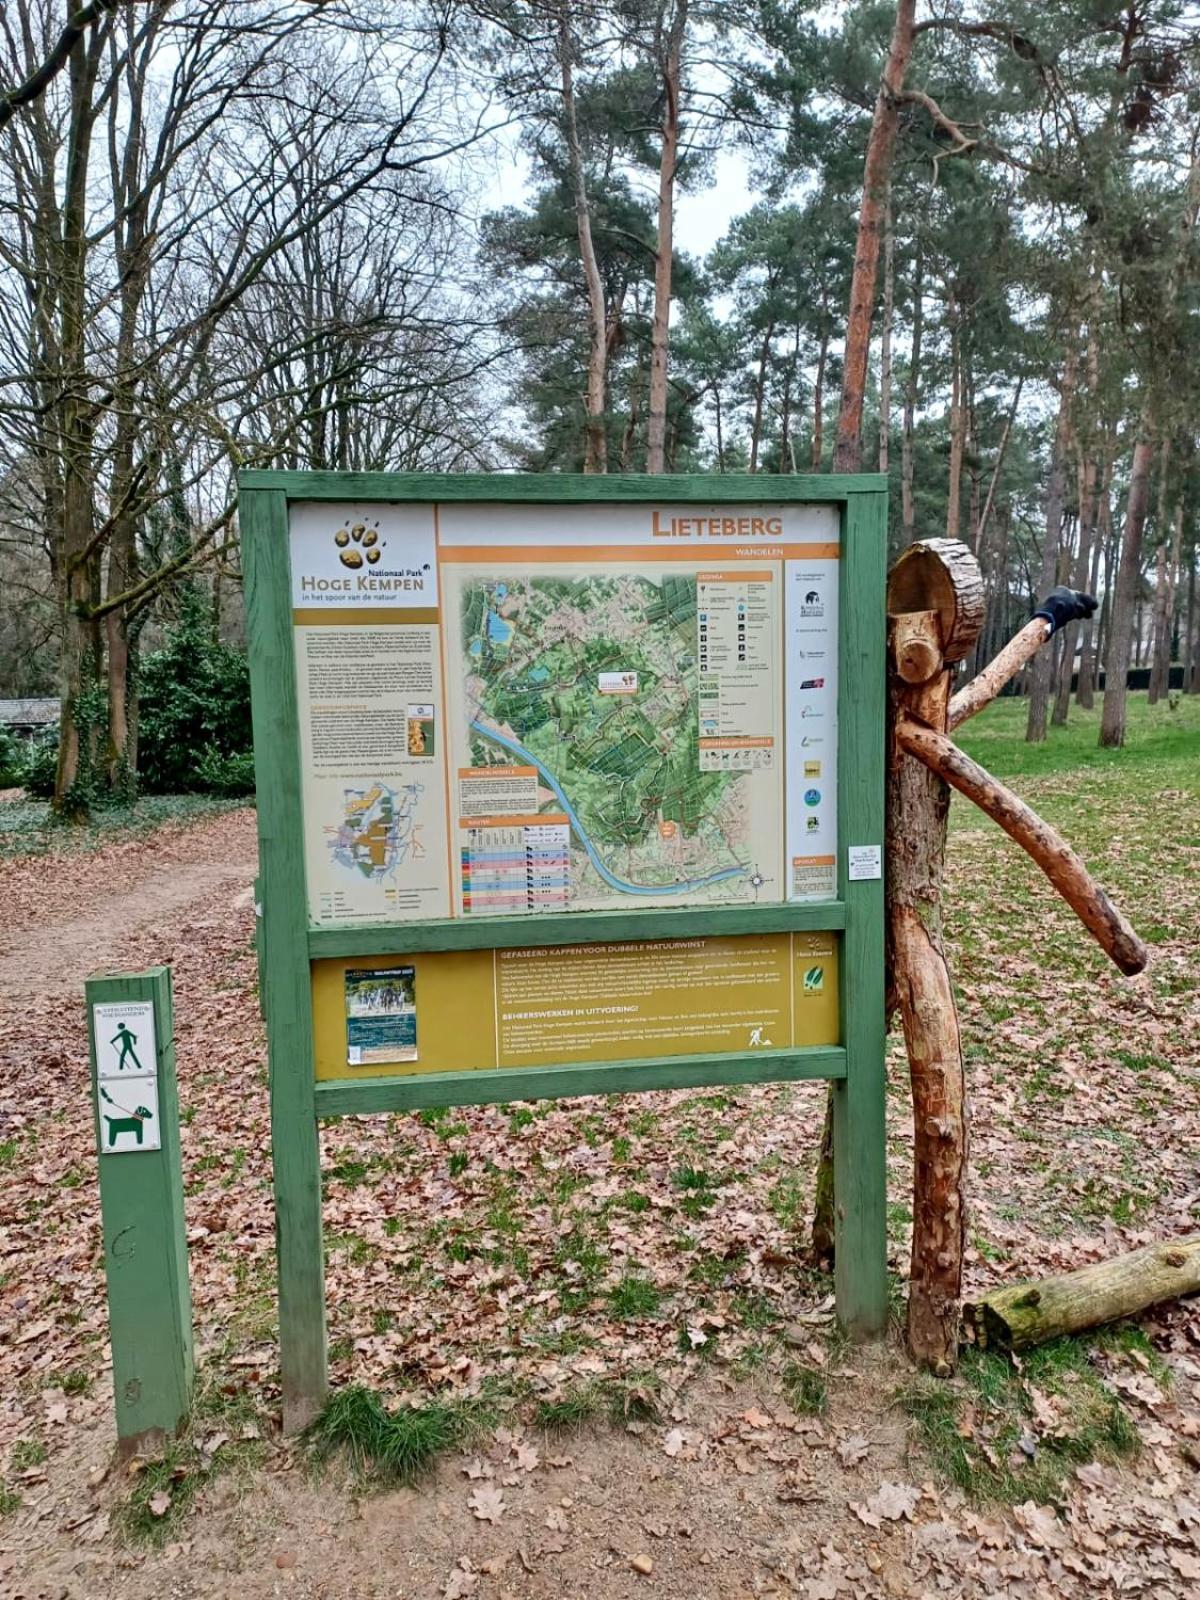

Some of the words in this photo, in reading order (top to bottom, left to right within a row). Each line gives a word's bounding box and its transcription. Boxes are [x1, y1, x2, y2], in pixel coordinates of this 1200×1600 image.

[652, 511, 783, 537] LIETEBERG
[735, 547, 784, 556] WANDELEN
[368, 569, 404, 577] Nationaal
[406, 569, 423, 577] Park
[301, 576, 352, 591] HOGE
[357, 575, 424, 591] KEMPEN
[302, 593, 310, 601] in
[311, 592, 323, 601] het
[325, 594, 346, 602] spoor
[362, 593, 372, 601] de
[501, 949, 548, 959] GEFASEERD
[549, 947, 582, 956] KAPPEN
[583, 946, 607, 954] VOOR
[607, 944, 645, 953] DUBBELE
[646, 940, 705, 951] NATUURWINST
[502, 1008, 574, 1020] BEHEERSWERKEN
[575, 1007, 585, 1016] IN
